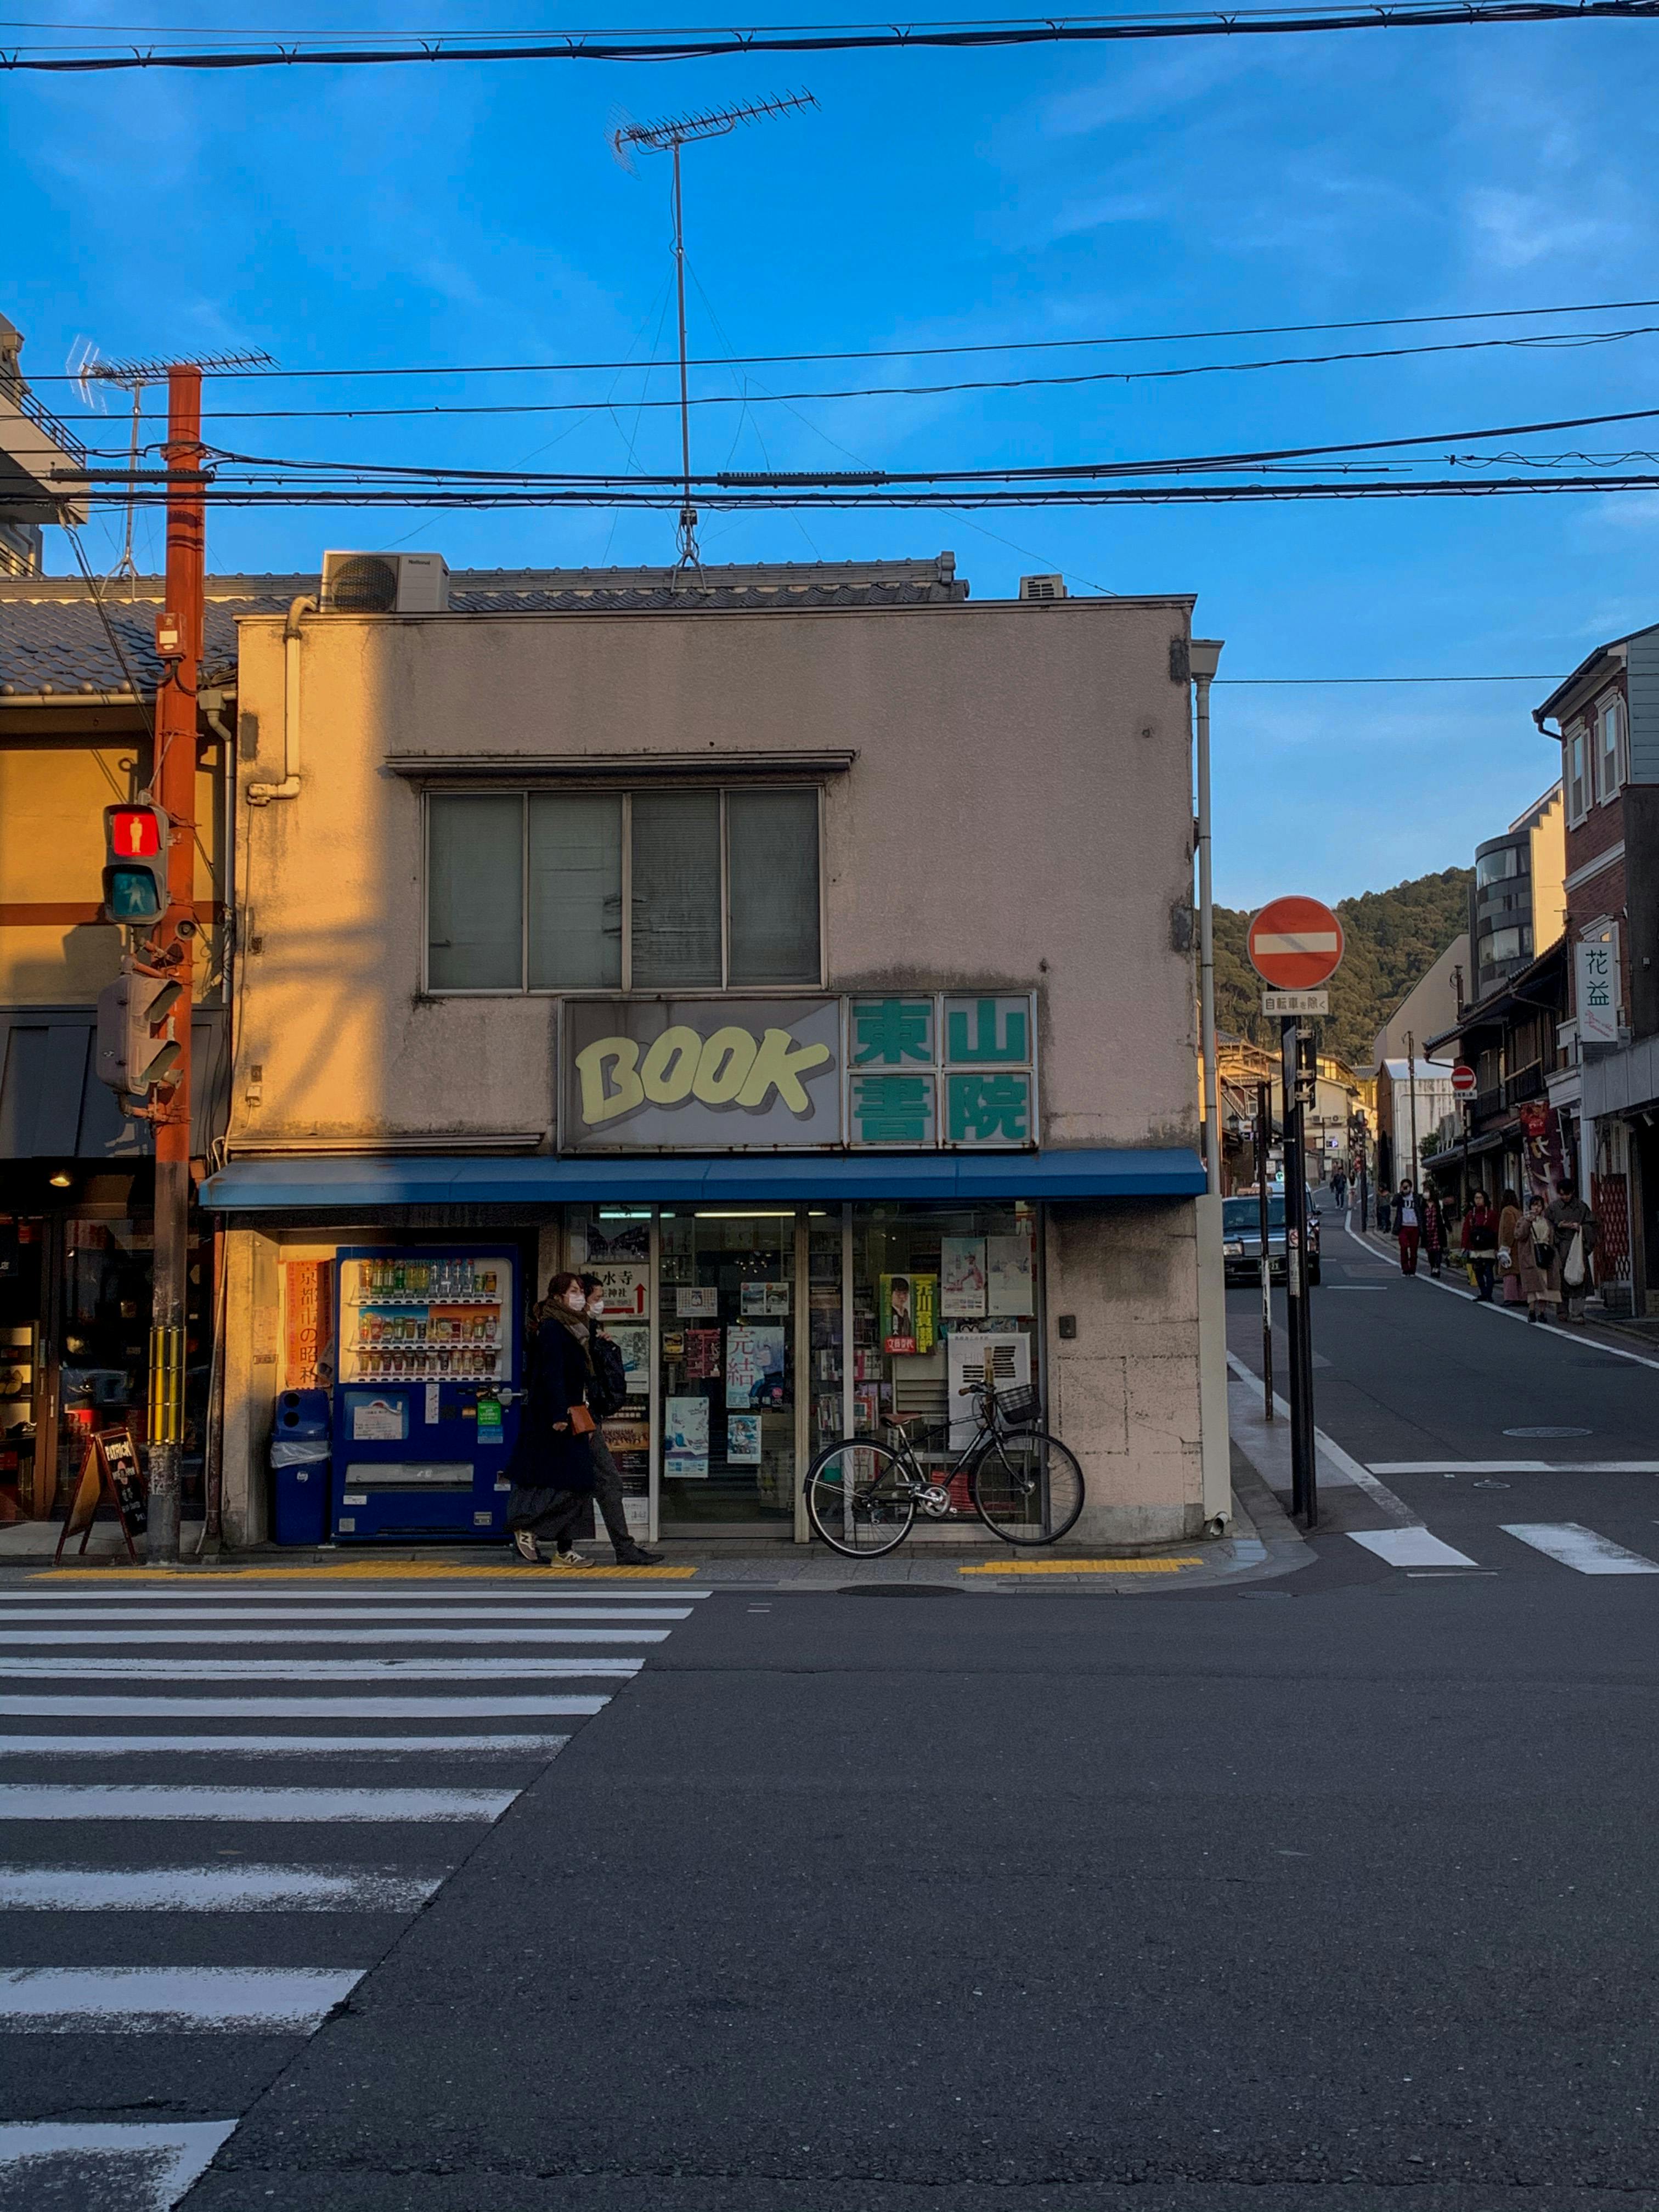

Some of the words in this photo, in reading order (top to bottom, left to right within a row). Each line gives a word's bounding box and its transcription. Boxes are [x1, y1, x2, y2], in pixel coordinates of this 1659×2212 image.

[1265, 996, 1325, 1010] 自転車を除く
[1585, 949, 1610, 1006] 花益
[853, 998, 1026, 1064] 東山
[574, 1024, 831, 1126] BOOK
[853, 1074, 1027, 1141] 書院
[586, 1271, 633, 1285] 水寺
[727, 1327, 755, 1387] 完結
[104, 1441, 132, 1462] PATRICK
